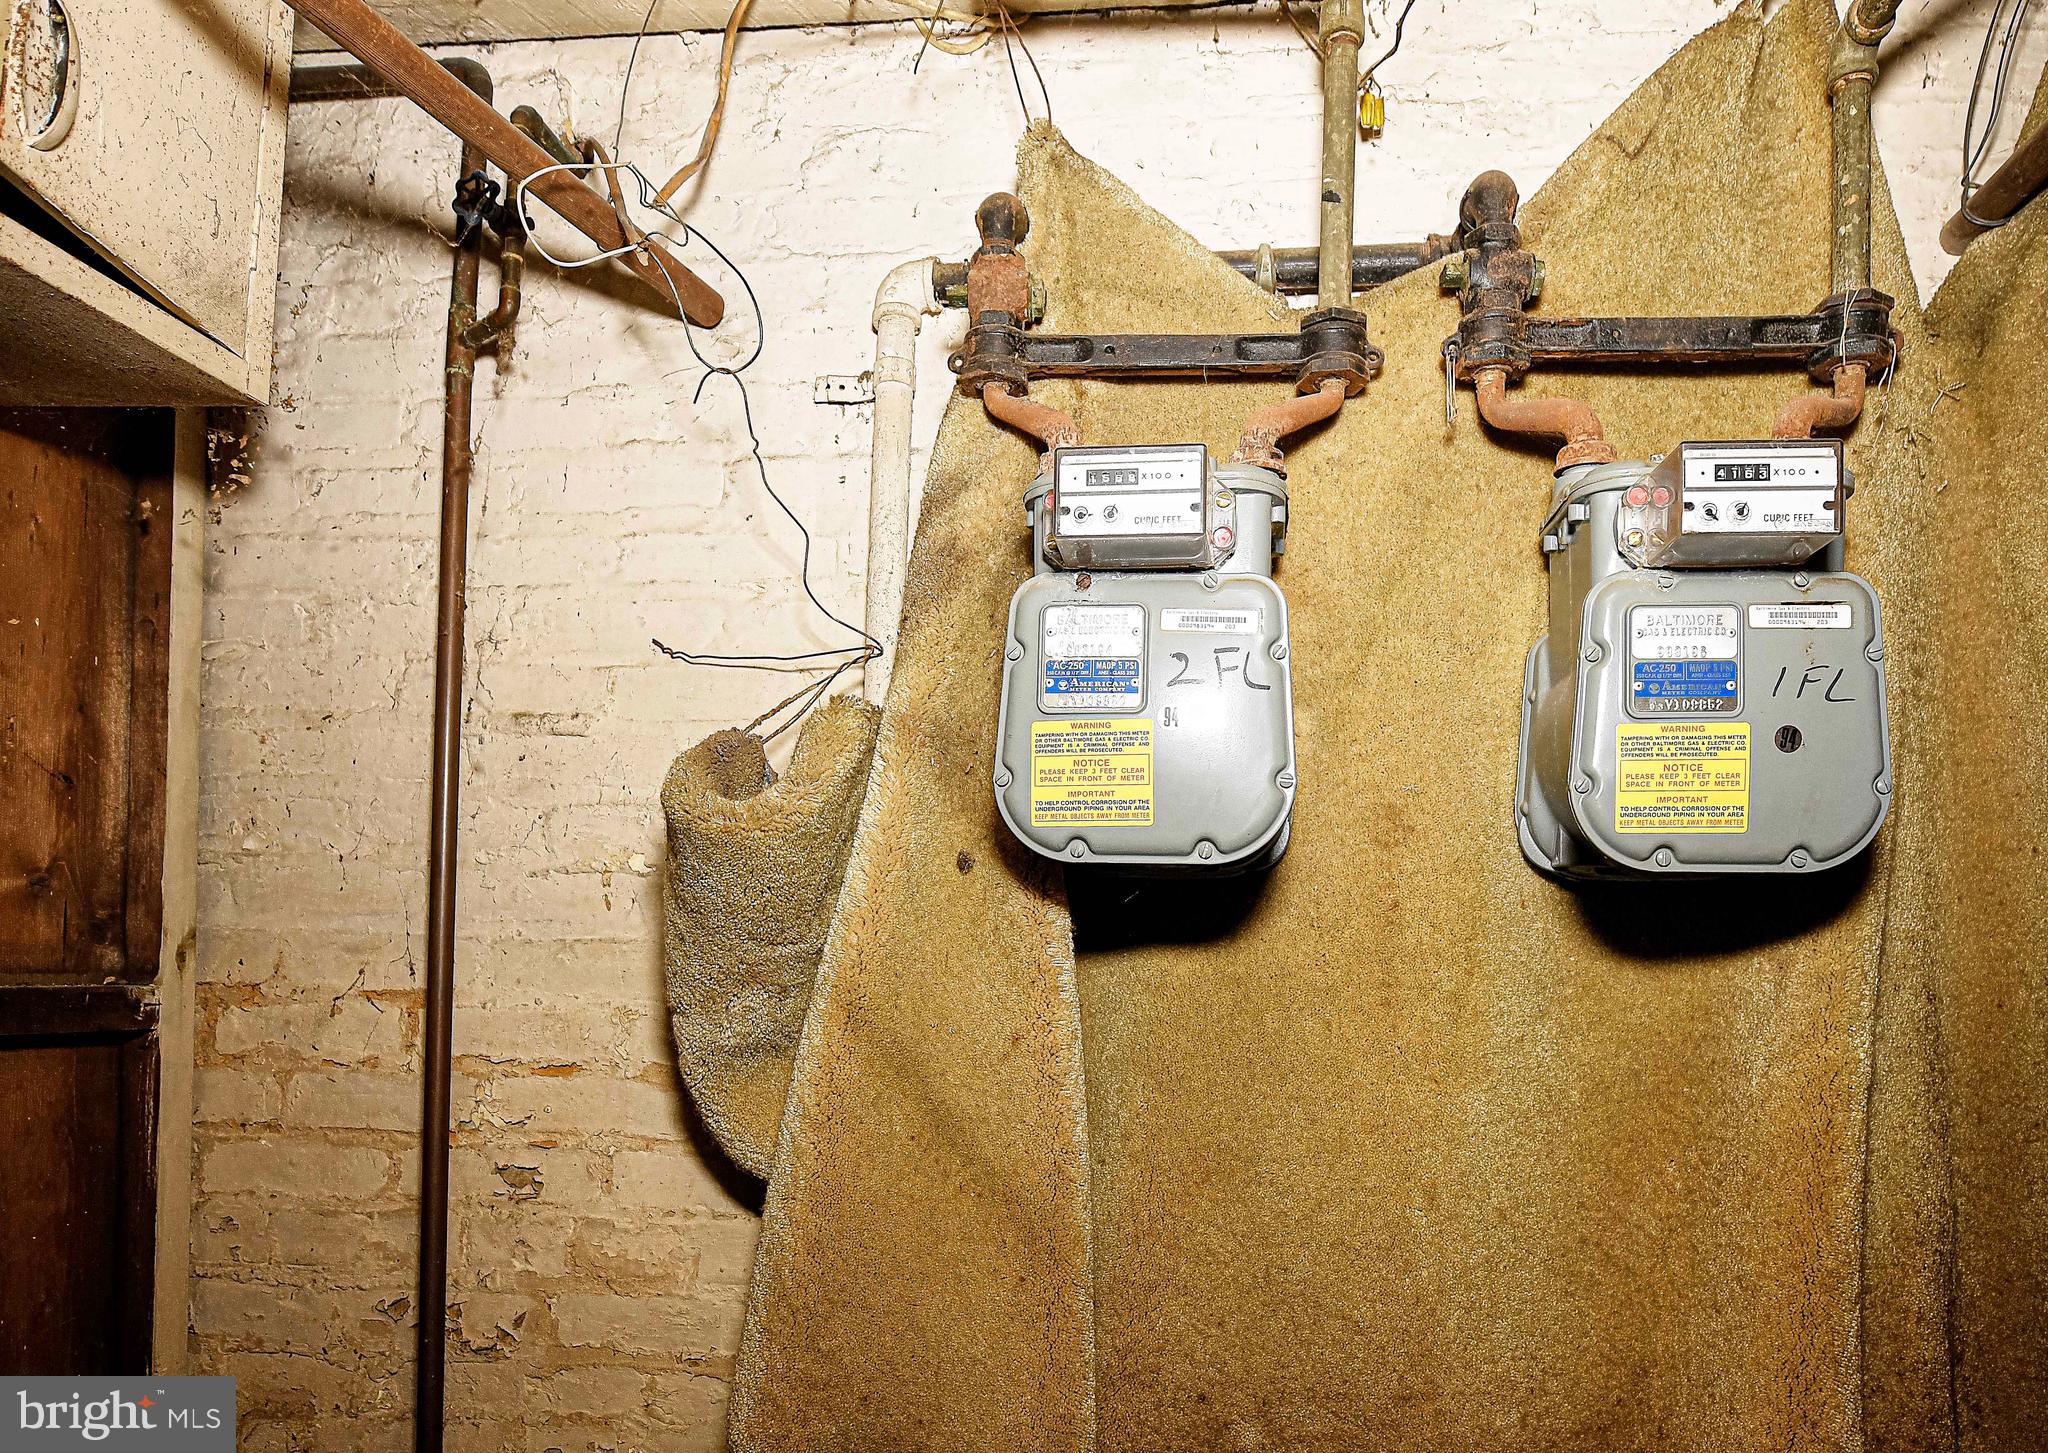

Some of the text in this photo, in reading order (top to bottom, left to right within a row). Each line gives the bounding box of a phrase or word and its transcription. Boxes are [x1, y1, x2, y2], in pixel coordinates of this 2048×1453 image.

[1793, 513, 1814, 521] FEET
[1647, 614, 1723, 626] BALTIMORE
[1671, 627, 1711, 636] ELECTRIC
[1097, 661, 1137, 669] MAOP 5 PSI
[1167, 647, 1270, 690] 2 FL
[1642, 664, 1676, 672] AC-250
[1796, 665, 1856, 702] FL
[1164, 707, 1178, 727] 94
[1779, 728, 1797, 750] 94
[1073, 759, 1110, 767] NOTICE
[1663, 764, 1703, 772] NOTICE
